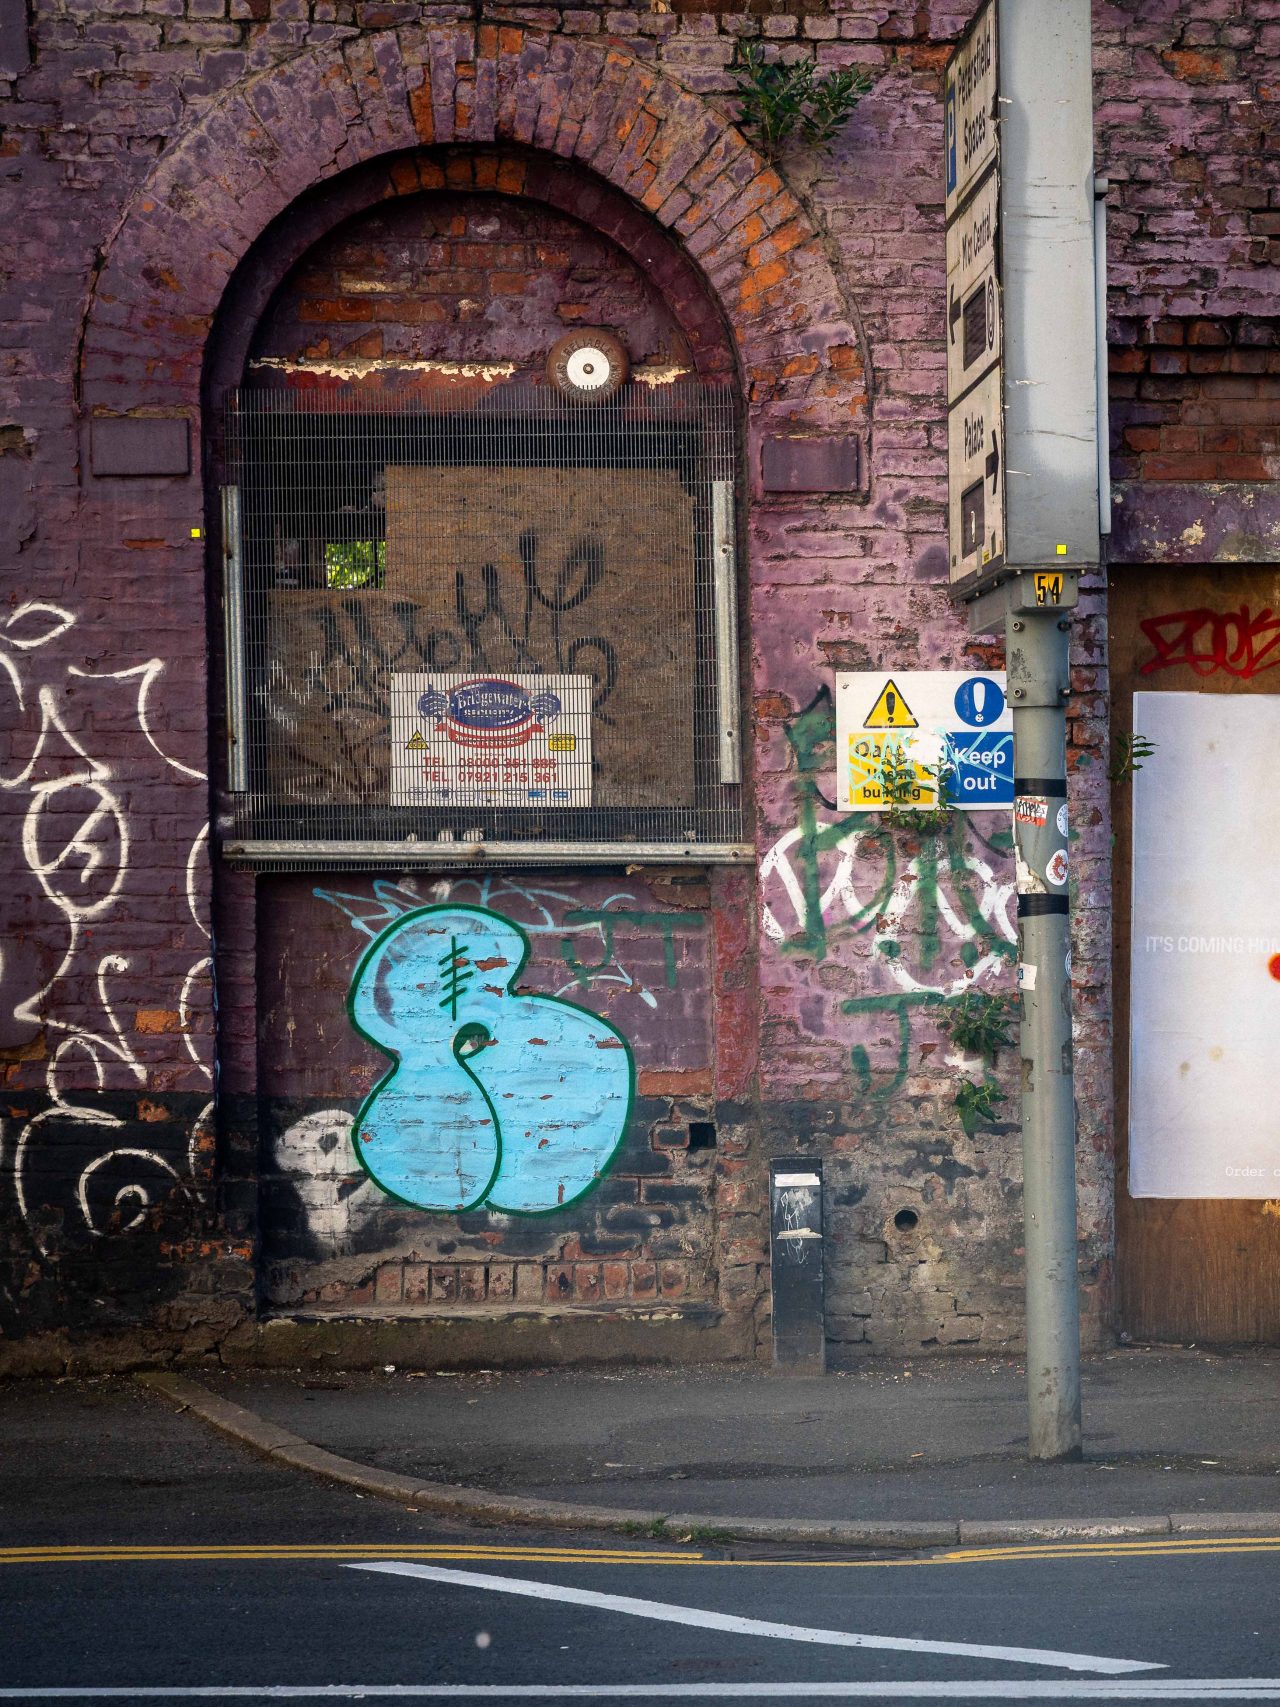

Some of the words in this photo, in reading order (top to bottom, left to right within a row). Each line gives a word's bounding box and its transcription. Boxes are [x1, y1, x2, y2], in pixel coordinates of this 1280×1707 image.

[964, 104, 986, 169] Spaces
[973, 202, 991, 257] Central
[963, 411, 984, 462] Palace
[1036, 575, 1060, 605] 54
[954, 747, 1006, 768] Keep
[458, 771, 499, 783] 07921
[503, 772, 528, 782] 215
[534, 772, 557, 782] 361
[963, 774, 997, 791] out
[1145, 936, 1174, 953] IT'S
[1177, 936, 1244, 953] COMING
[1225, 1166, 1266, 1177] Order
